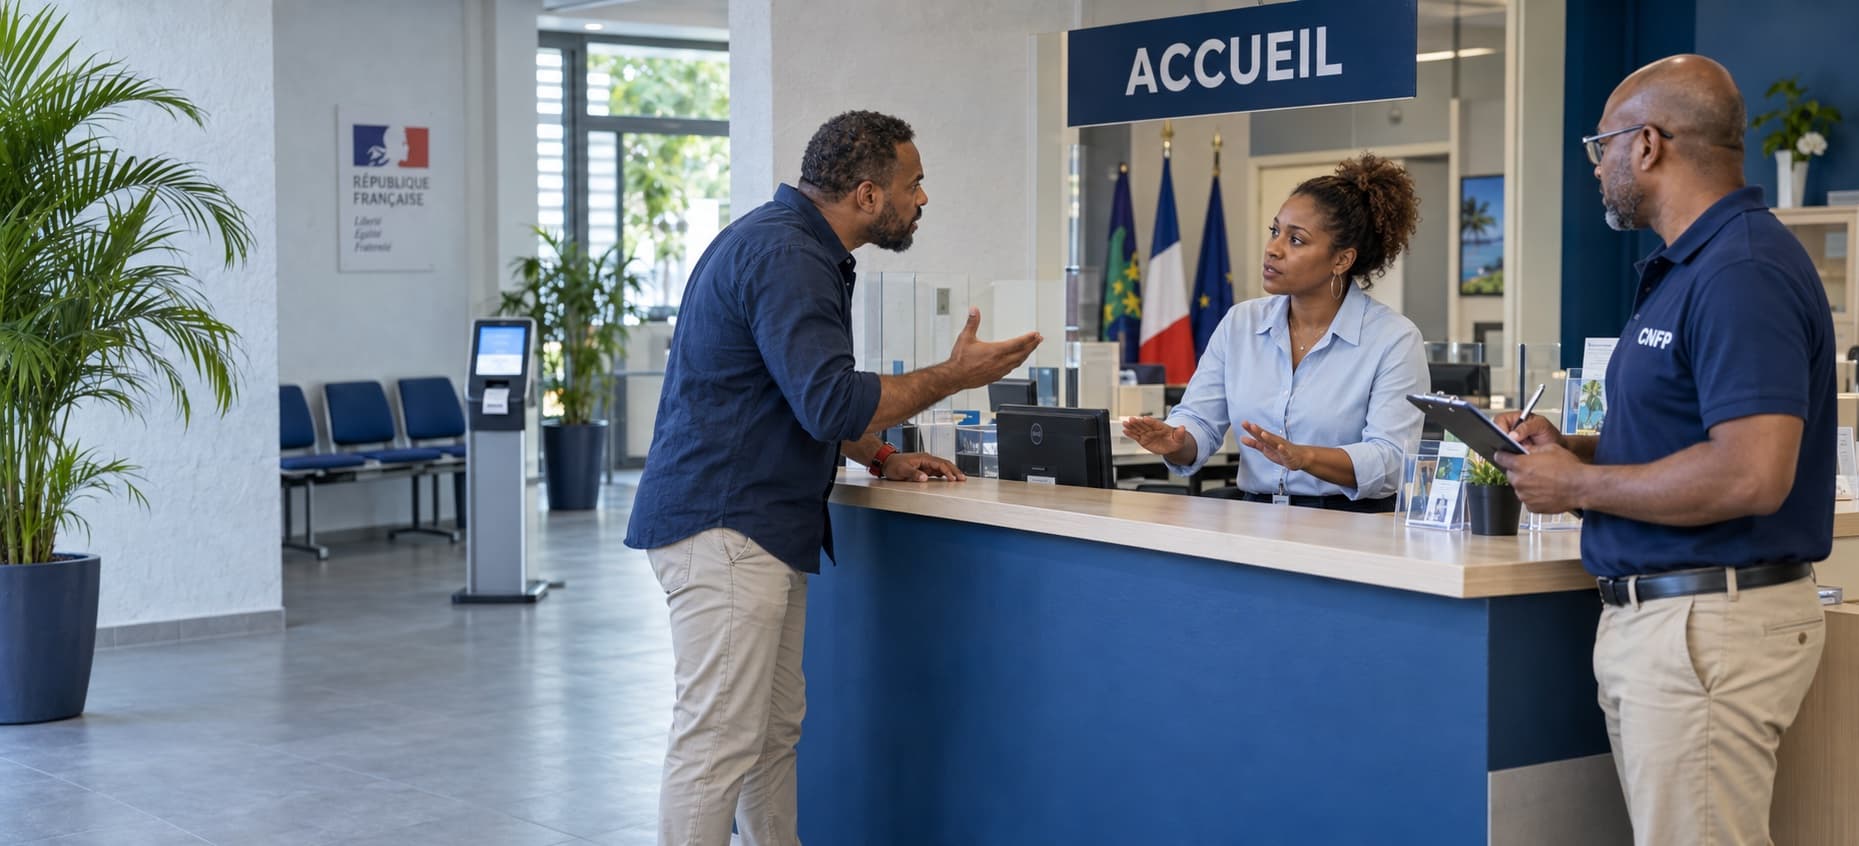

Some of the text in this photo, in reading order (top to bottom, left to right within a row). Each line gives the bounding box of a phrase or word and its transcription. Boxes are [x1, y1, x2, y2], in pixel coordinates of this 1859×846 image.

[1125, 26, 1342, 96] ACCUEIL
[353, 172, 430, 190] RÉPUBLIQUE
[353, 192, 424, 208] FRANÇAISE
[1638, 327, 1673, 349] CNFP
